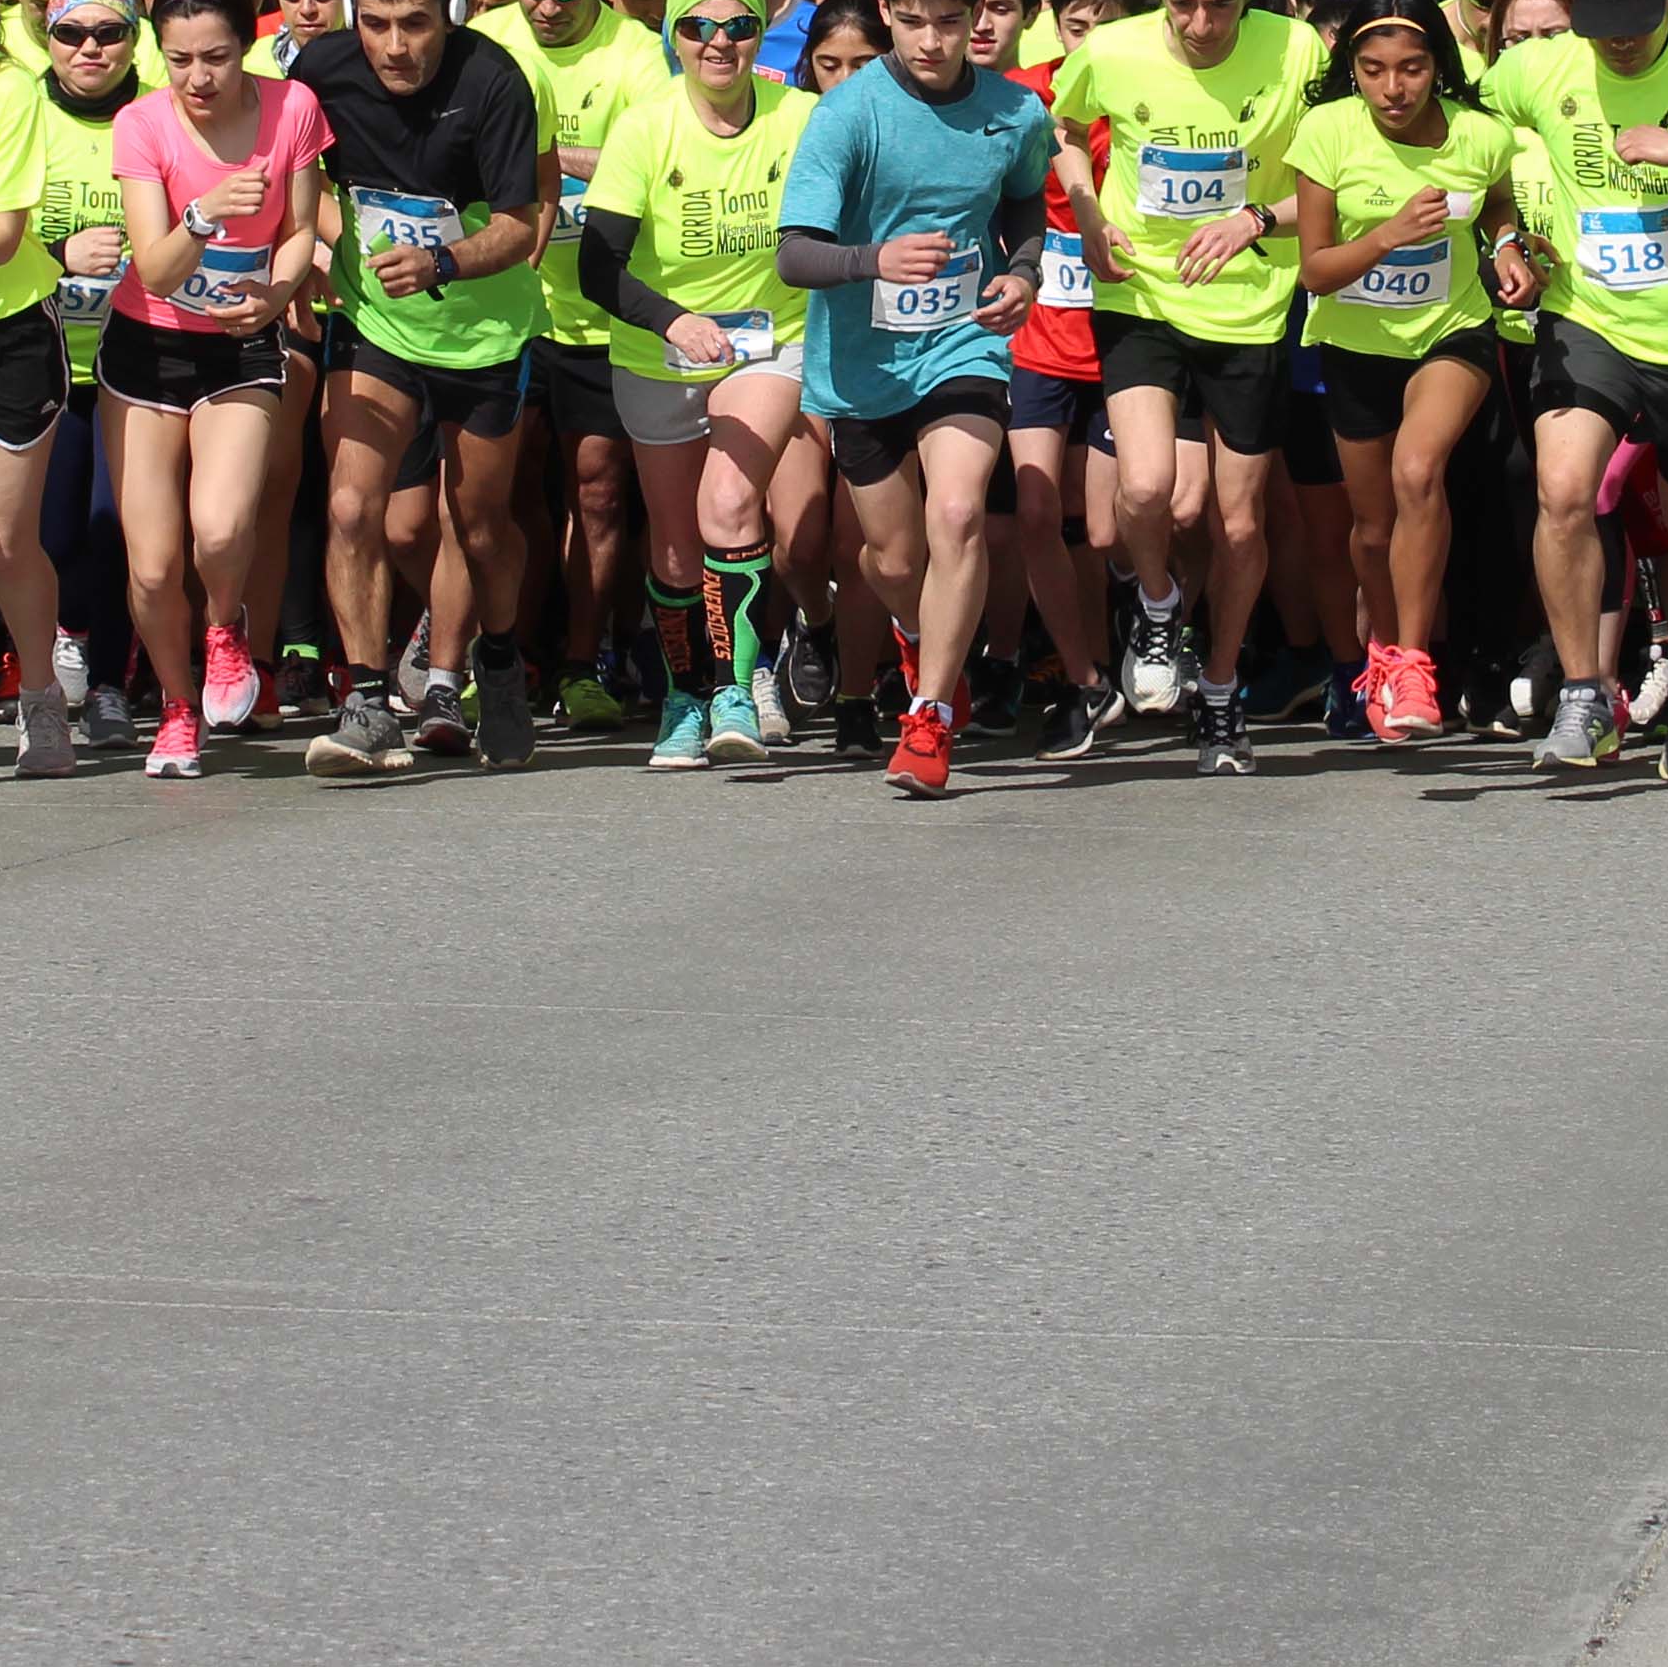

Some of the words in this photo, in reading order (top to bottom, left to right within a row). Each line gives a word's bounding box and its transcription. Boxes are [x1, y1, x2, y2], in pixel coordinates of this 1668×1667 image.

[557, 115, 579, 131] ma
[1186, 125, 1239, 149] Toma
[1573, 123, 1606, 189] CORRIDA
[718, 188, 769, 216] Toma
[1160, 178, 1226, 205] 104
[556, 203, 590, 229] 16
[680, 189, 713, 258] CORRIDA
[380, 219, 442, 250] 435
[716, 222, 782, 258] Magallan
[1598, 242, 1665, 274] 518
[1058, 264, 1092, 290] 07
[1362, 269, 1431, 296] 040
[63, 283, 110, 312] 57
[896, 284, 961, 315] 035
